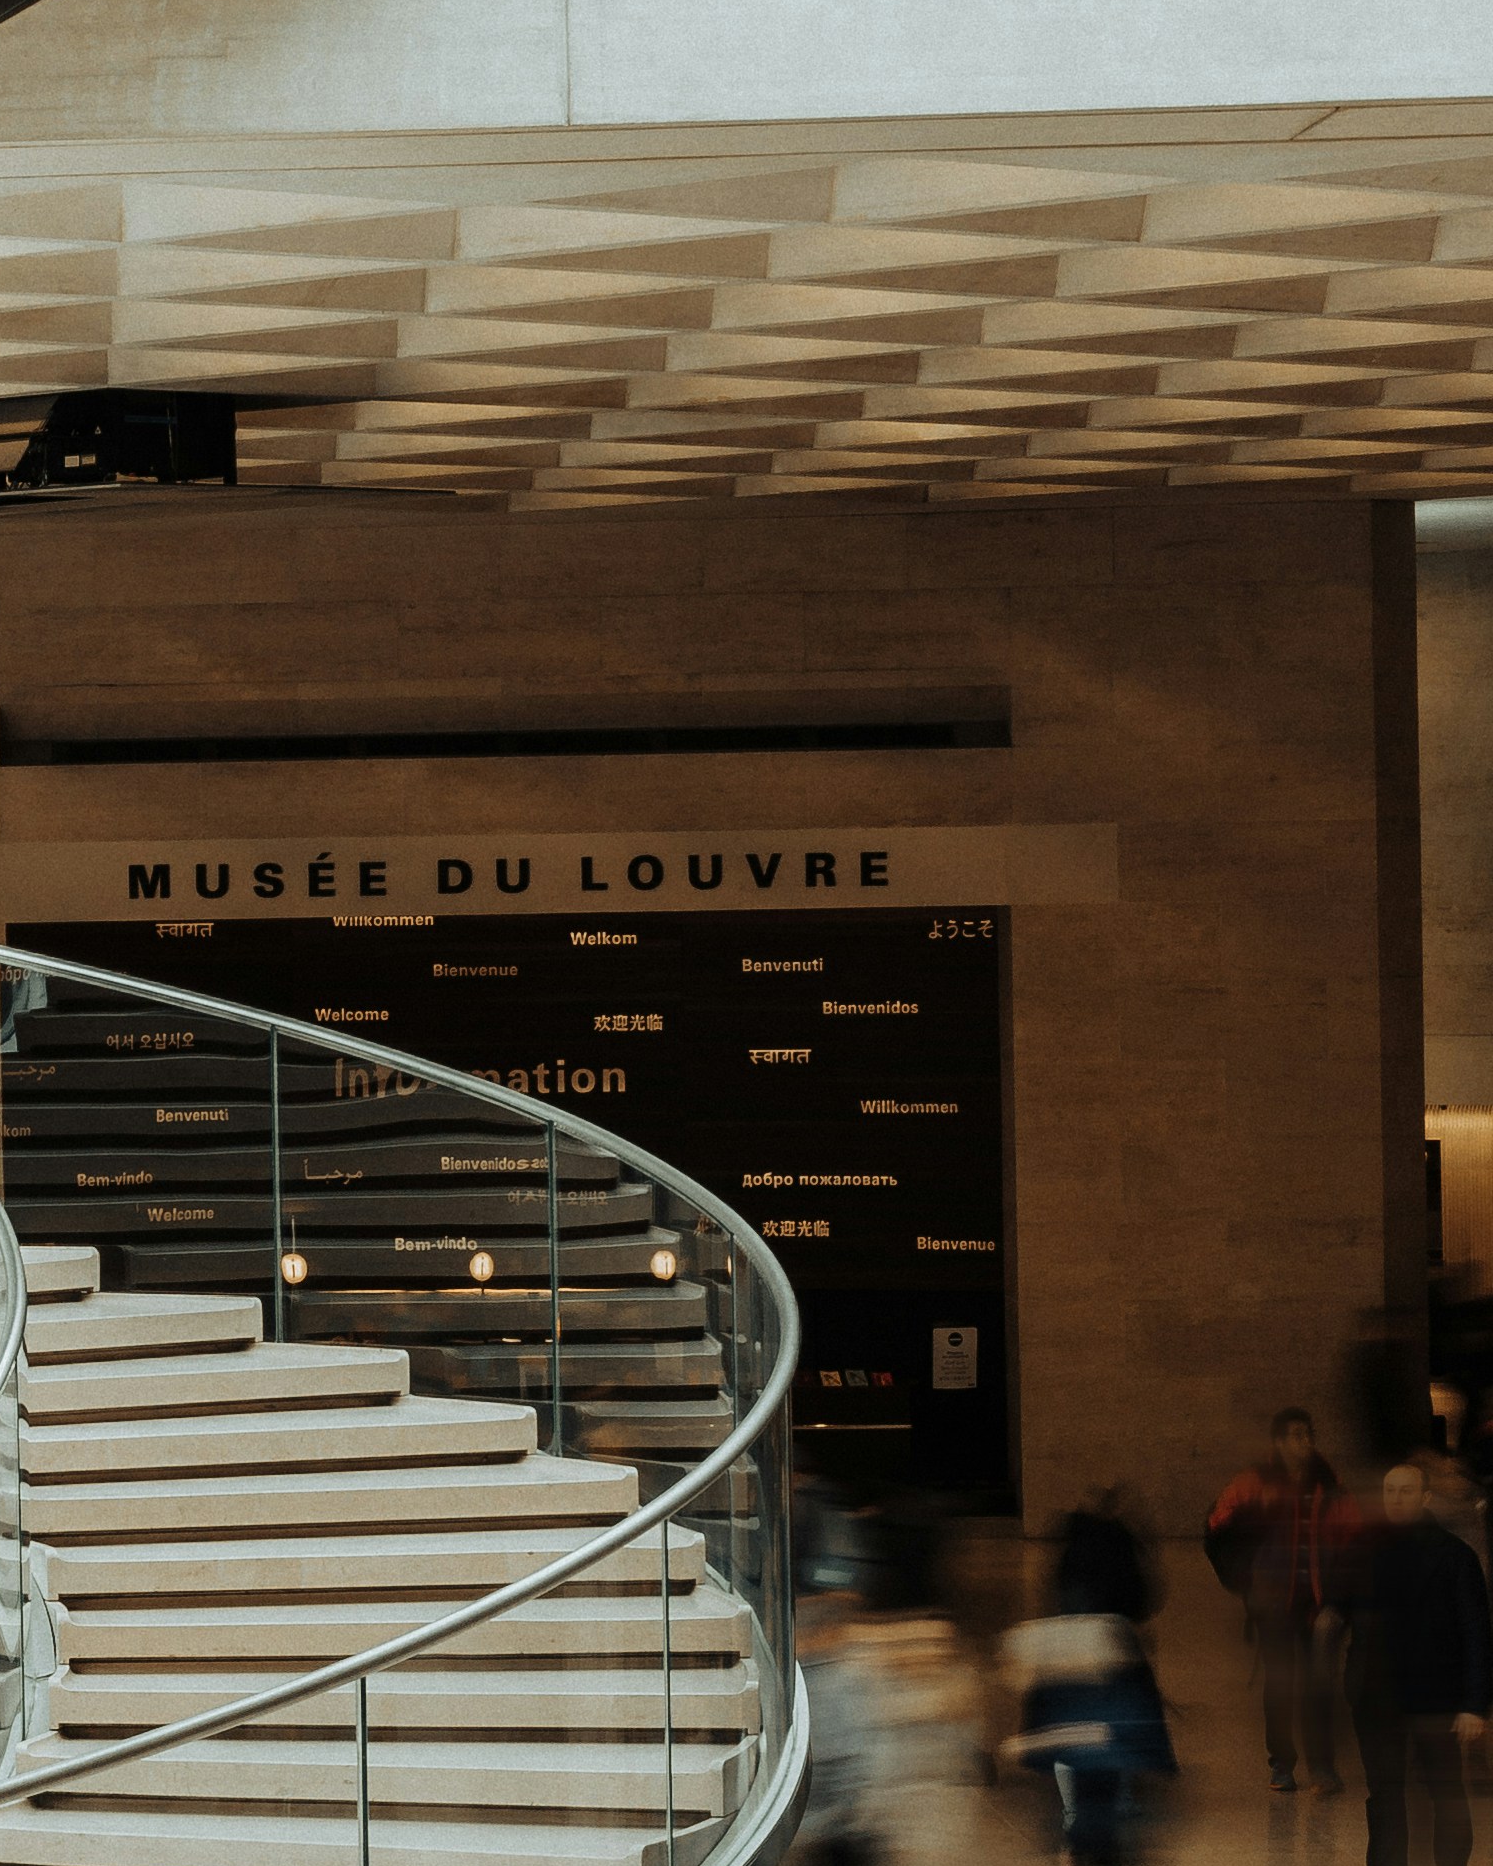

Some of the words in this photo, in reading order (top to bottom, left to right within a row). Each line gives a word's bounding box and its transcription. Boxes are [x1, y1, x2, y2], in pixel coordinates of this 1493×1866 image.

[128, 851, 388, 899] MUSÉE
[437, 858, 531, 894] DU
[580, 851, 889, 892] LOUVRE
[155, 921, 215, 939] स्वागत
[927, 919, 994, 939] ようこそ
[570, 931, 638, 946] Welkom
[432, 963, 519, 978] Bienvenue
[741, 957, 824, 973] Benvenuti
[315, 1007, 390, 1022] Welcome
[822, 1000, 919, 1015] Bienvenidos
[593, 1014, 664, 1032] 欢迎光临
[106, 1033, 134, 1050] 어서
[140, 1032, 195, 1050] 오십시오
[748, 1048, 812, 1064] स्वागत
[860, 1100, 959, 1114] Willkommen
[156, 1108, 230, 1123] Benvenuti
[76, 1171, 154, 1187] Bem-vindo
[799, 1174, 898, 1186] пожаловать
[147, 1207, 215, 1223] Welcome
[762, 1220, 830, 1238] 欢迎光临
[394, 1236, 478, 1251] Bem-vindo
[916, 1236, 996, 1251] Bienvenue
